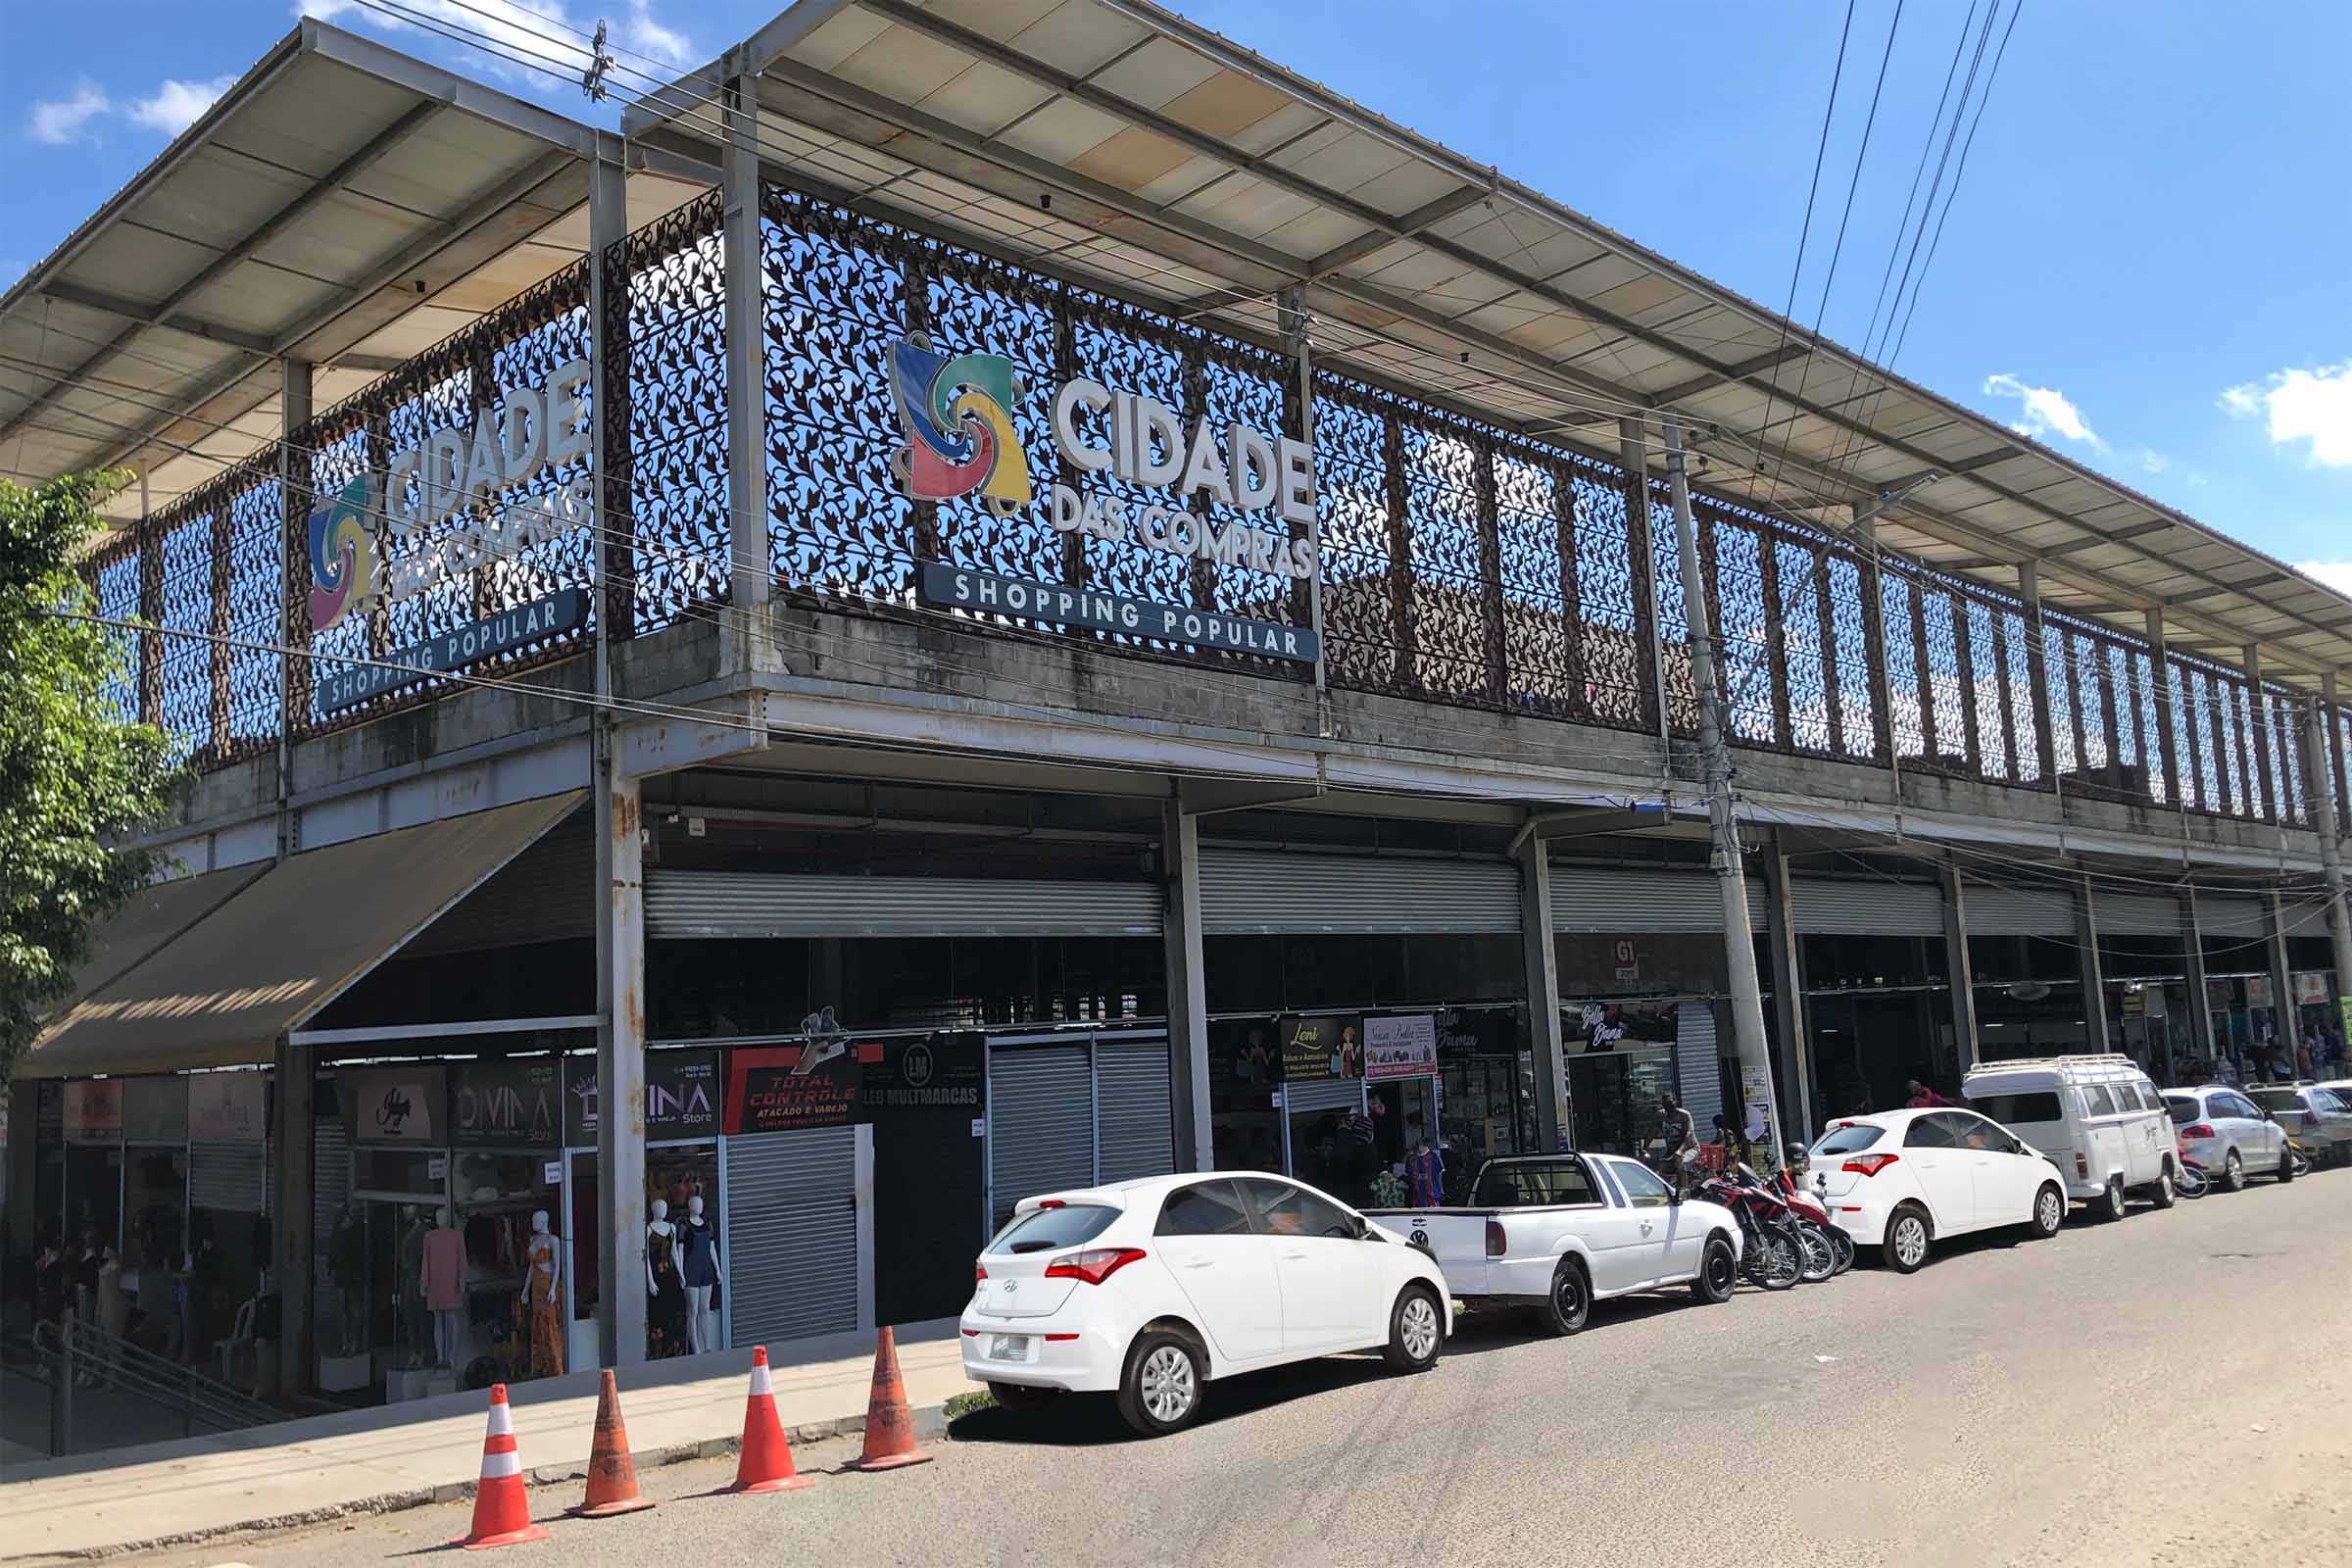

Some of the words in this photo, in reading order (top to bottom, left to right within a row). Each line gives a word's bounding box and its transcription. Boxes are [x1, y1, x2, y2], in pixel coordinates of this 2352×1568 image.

[387, 359, 592, 535] CIDADE
[1051, 378, 1314, 523] CIDADE
[1051, 484, 1125, 541] DAS
[1139, 504, 1312, 579] COMPRAS
[330, 647, 434, 703] SHOPPING
[447, 600, 558, 662] POPULAR
[956, 574, 1140, 628] SHOPPING
[1163, 611, 1298, 655] POPULAR
[682, 1112, 712, 1124] Store
[749, 1088, 856, 1106] CONTROLE
[757, 1105, 803, 1119] ATACADO
[814, 1103, 848, 1114] VAREJO
[769, 1074, 835, 1089] TOTAL
